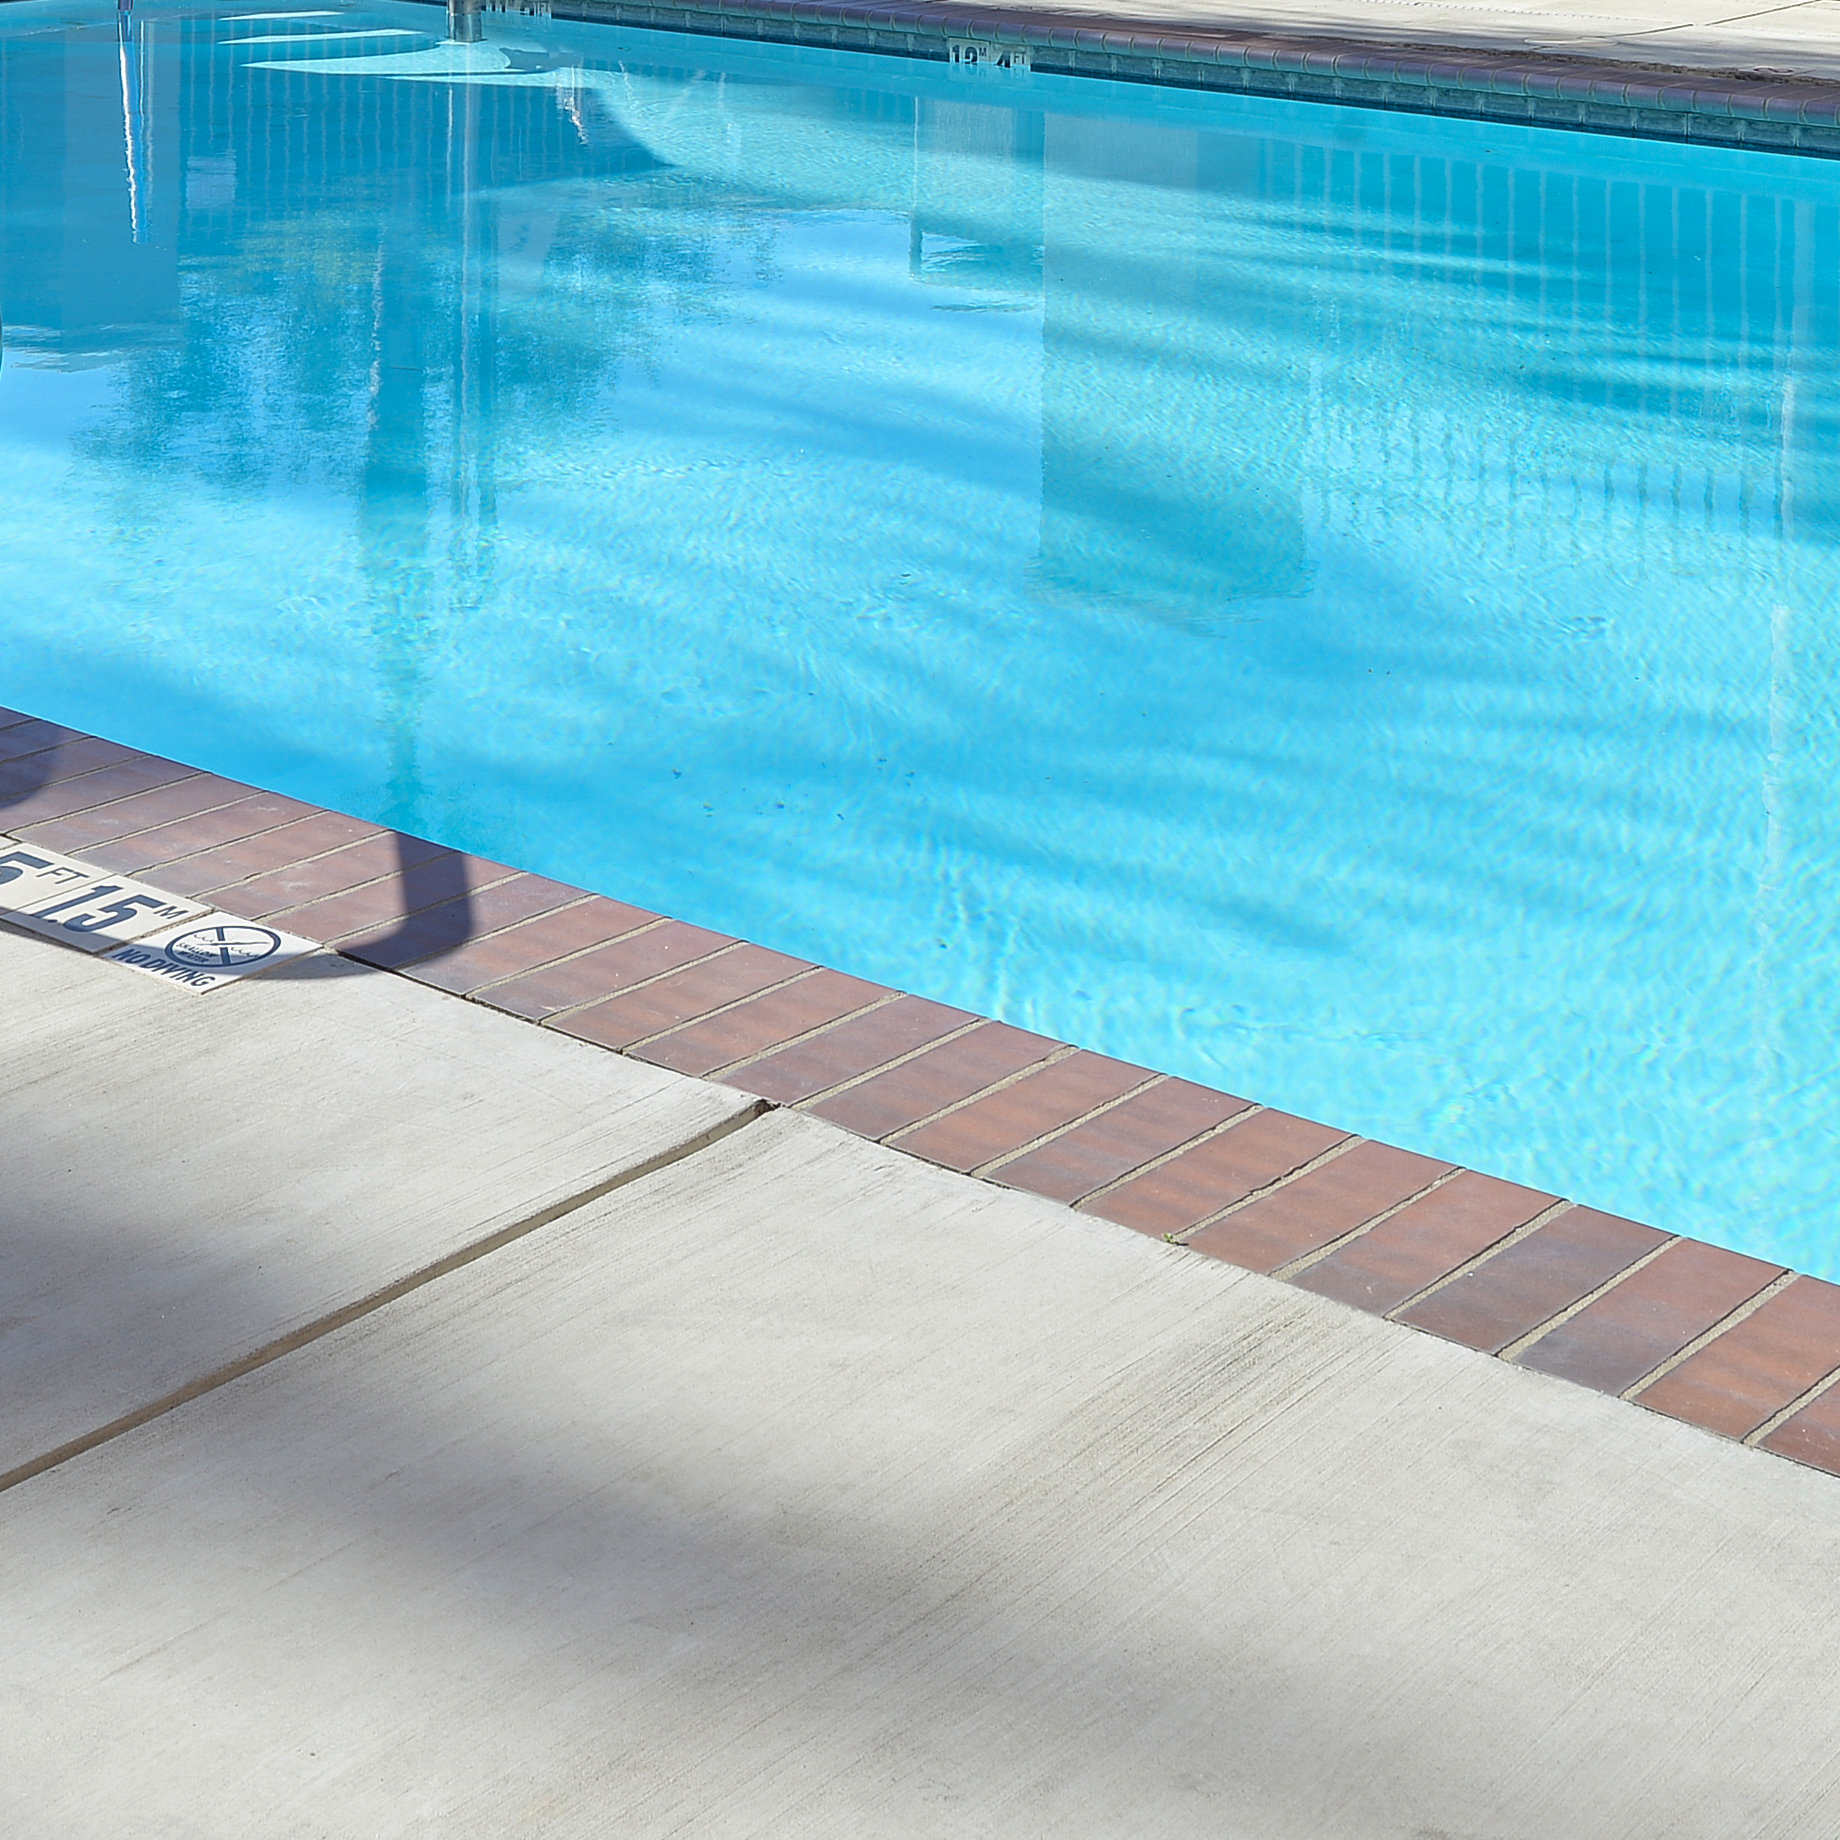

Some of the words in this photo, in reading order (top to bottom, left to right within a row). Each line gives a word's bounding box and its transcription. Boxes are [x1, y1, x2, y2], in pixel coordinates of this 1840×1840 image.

[36, 866, 90, 885] FT
[30, 885, 167, 933] 1.5
[152, 905, 189, 920] M
[176, 942, 219, 958] SHALLOW
[177, 951, 211, 963] WATER
[111, 948, 147, 964] NO
[139, 958, 216, 987] DIVING
